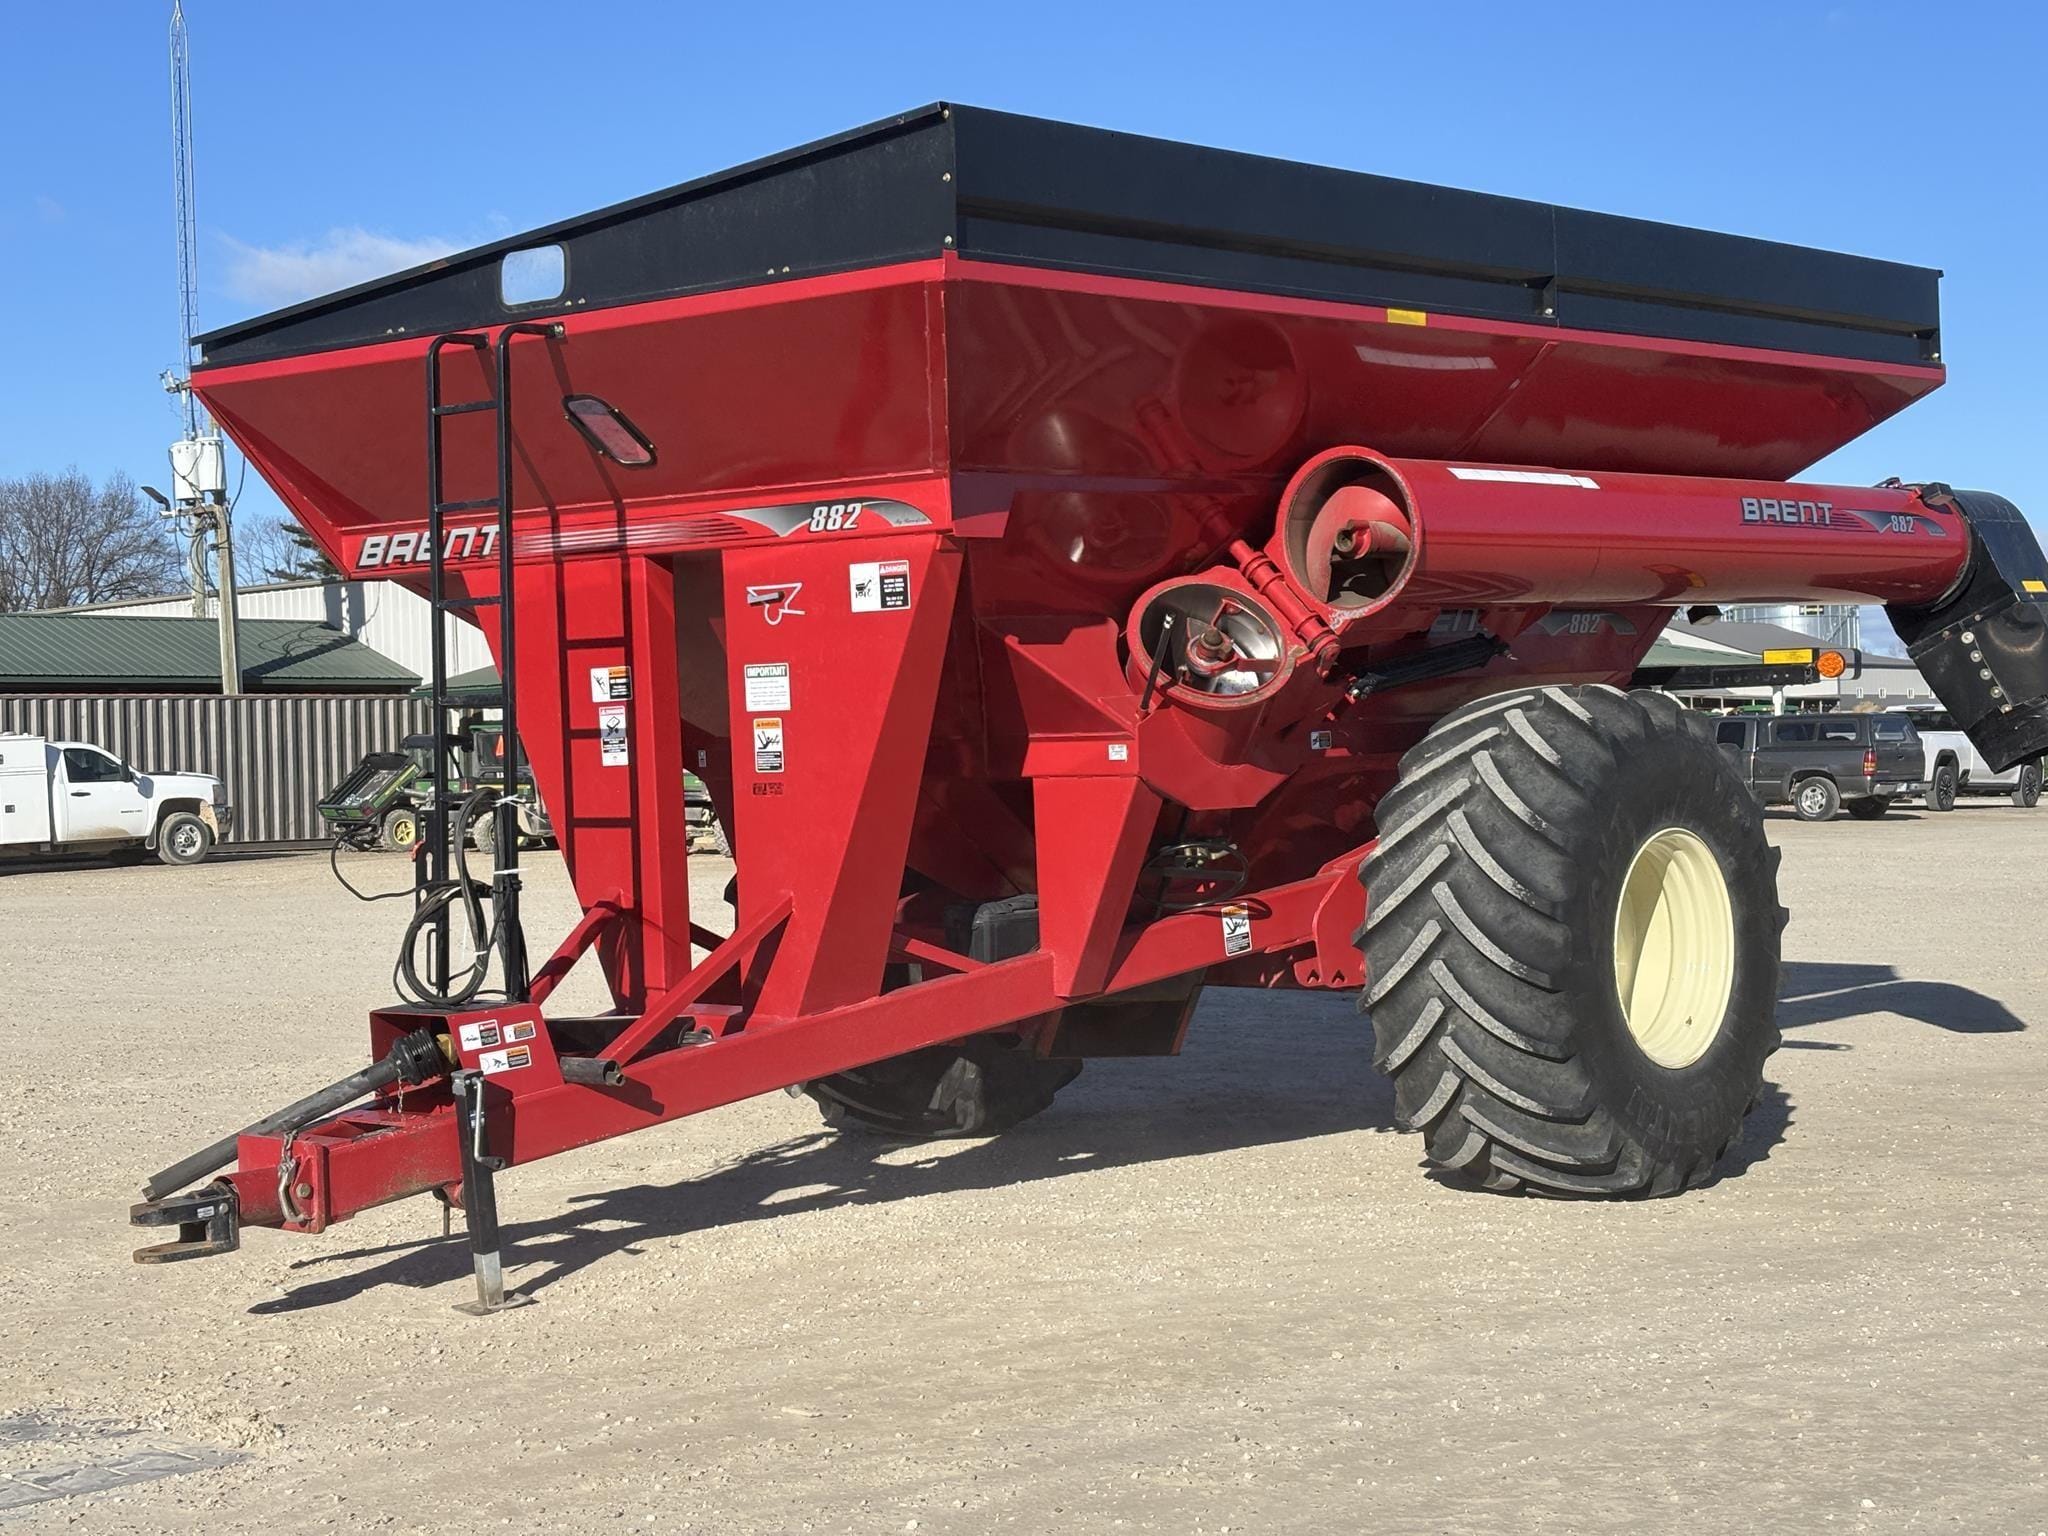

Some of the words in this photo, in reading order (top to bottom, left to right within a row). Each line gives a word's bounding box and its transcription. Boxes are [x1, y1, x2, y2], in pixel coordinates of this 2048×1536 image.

[809, 502, 862, 532] 882
[1741, 497, 1833, 525] BRENT
[1891, 515, 1915, 533] 882
[1569, 614, 1600, 634] 882
[747, 666, 786, 677] IMPORTANT
